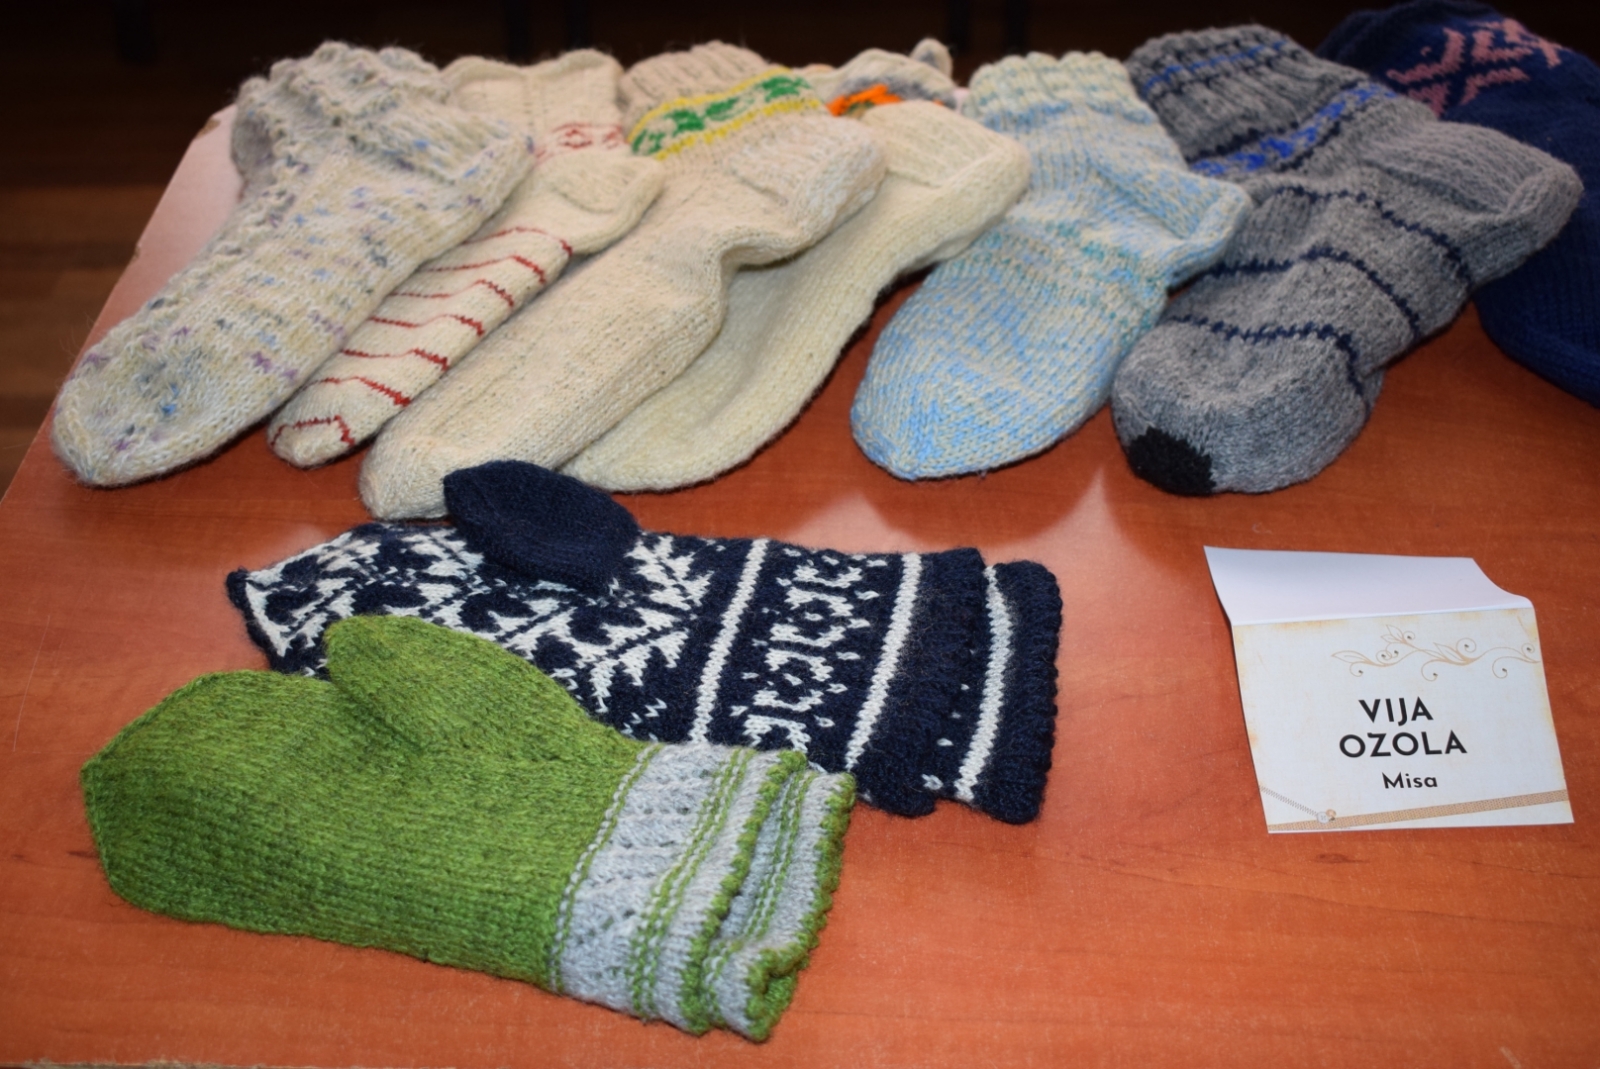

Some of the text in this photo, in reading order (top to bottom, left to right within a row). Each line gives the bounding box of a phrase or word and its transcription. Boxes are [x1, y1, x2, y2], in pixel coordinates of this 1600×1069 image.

[1358, 696, 1434, 727] VIJA
[1339, 730, 1468, 758] OZOLA
[1382, 772, 1439, 789] Misa
